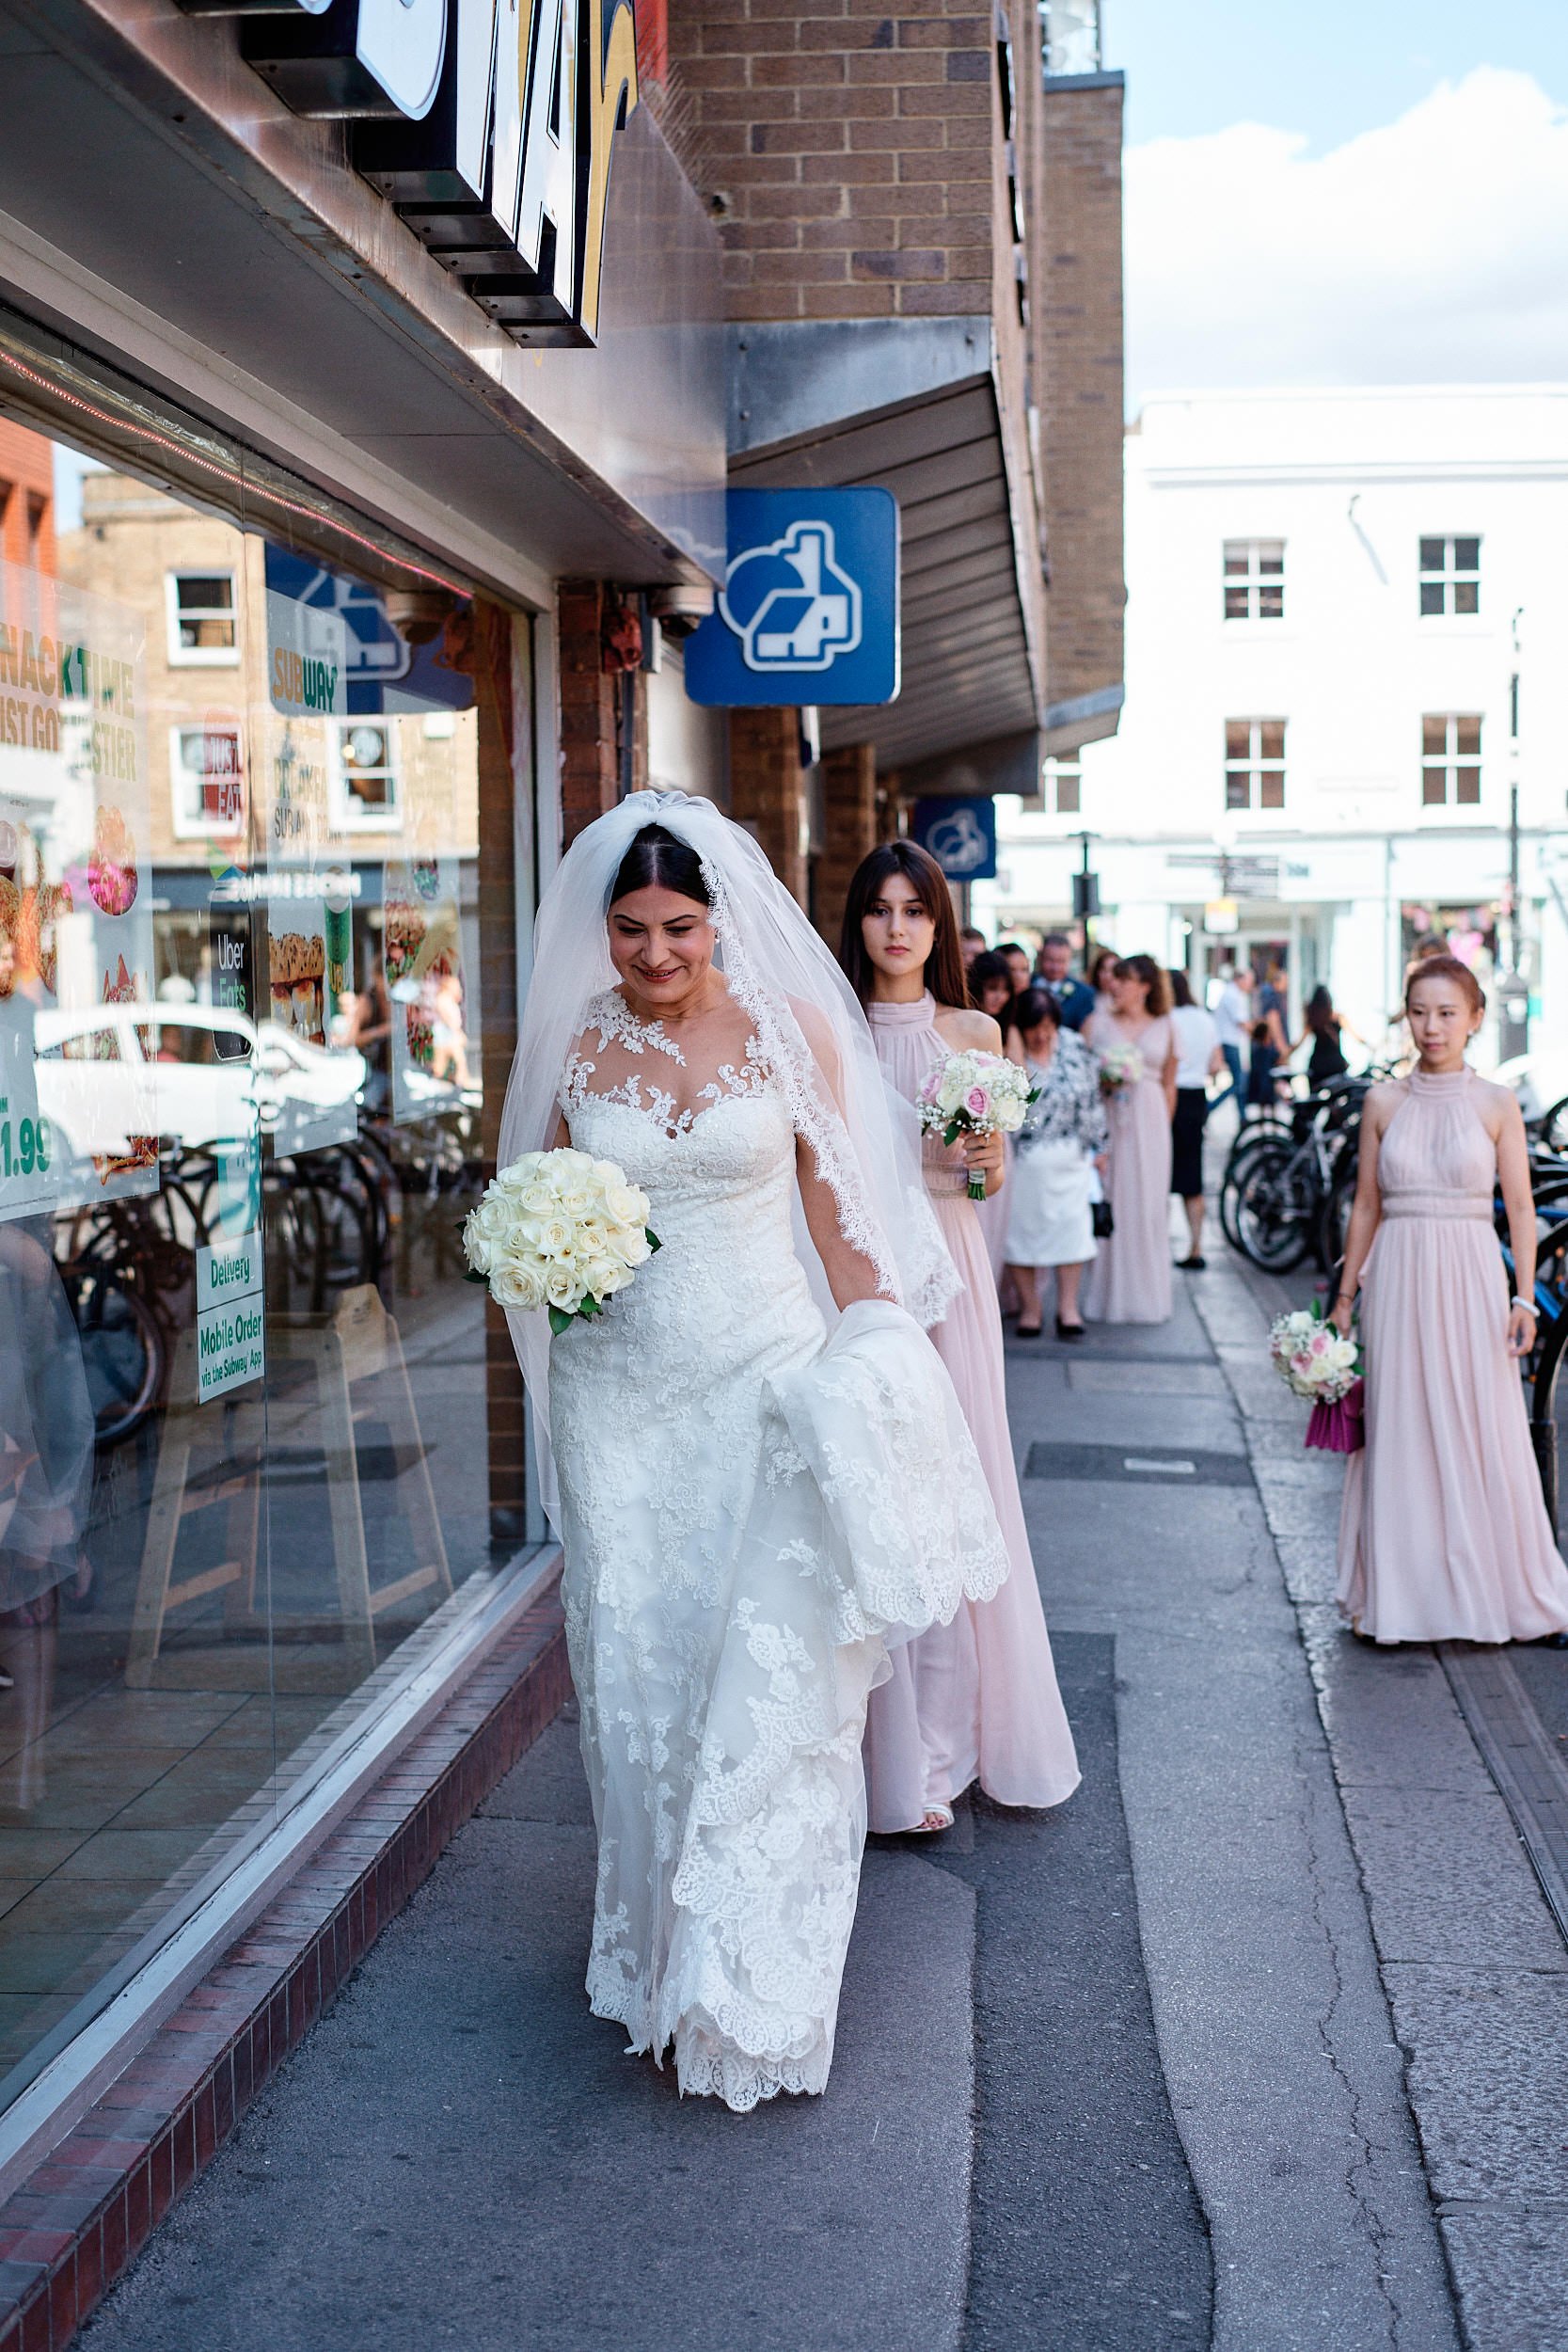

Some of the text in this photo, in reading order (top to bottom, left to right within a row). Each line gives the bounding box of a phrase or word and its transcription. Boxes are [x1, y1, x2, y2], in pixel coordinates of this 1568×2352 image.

[77, 647, 135, 720] TIME
[273, 646, 338, 713] SUBWAY
[210, 737, 237, 783] JUST
[218, 784, 241, 822] EAT
[275, 805, 293, 839] SUB
[217, 934, 245, 971] Uber
[219, 977, 246, 1012] Eats
[211, 1253, 250, 1289] Delivery
[200, 1310, 261, 1359] Mobile Order
[201, 1367, 212, 1389] via
[212, 1362, 223, 1384] the
[250, 1348, 261, 1371] App
